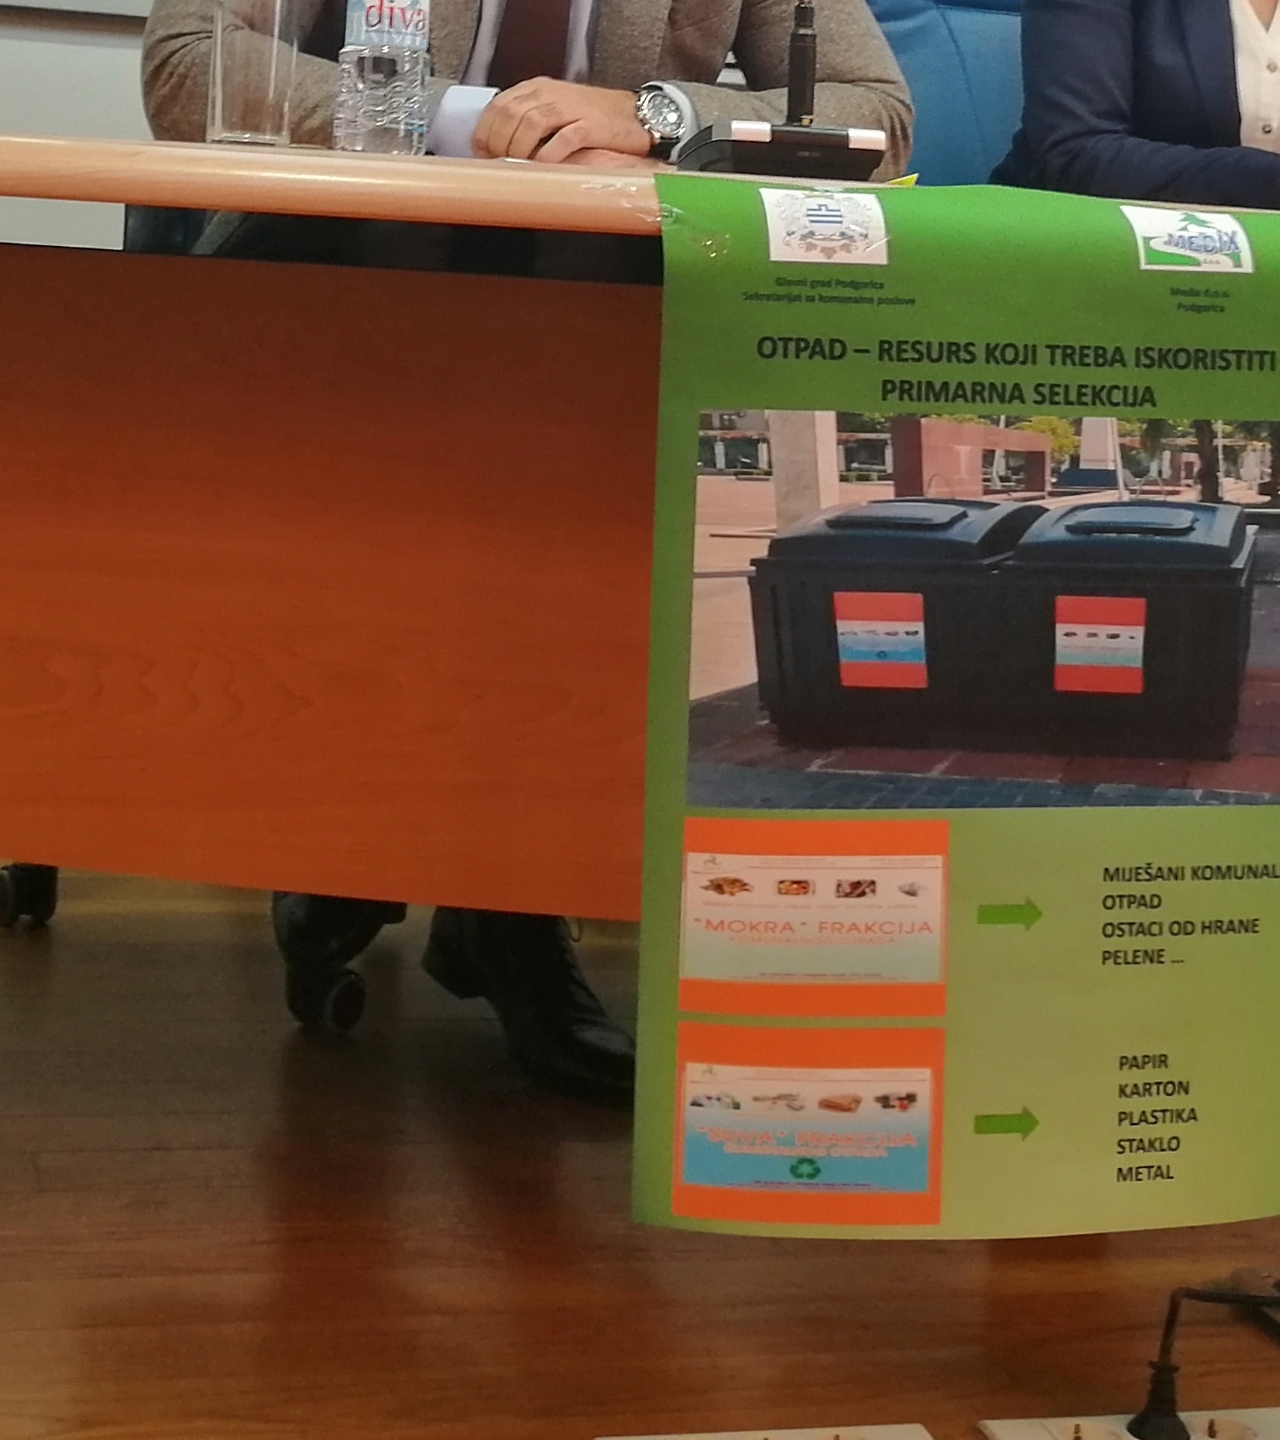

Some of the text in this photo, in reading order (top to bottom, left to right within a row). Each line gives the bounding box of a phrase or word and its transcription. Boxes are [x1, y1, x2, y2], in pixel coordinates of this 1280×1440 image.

[1166, 229, 1240, 255] MEDIX
[756, 335, 847, 361] OTPAD
[877, 338, 978, 364] RESURS
[984, 341, 1039, 368] KOJI
[1044, 343, 1126, 369] TREBA
[1133, 345, 1277, 372] ISKORISTITI
[880, 378, 1158, 408] PRIMARNA SELEKCIJA
[1102, 862, 1186, 883] MIJEŠANI
[1101, 893, 1163, 911] OTPAD
[818, 919, 934, 936] FRAKCIJA
[1101, 917, 1261, 938] OSTACI OD HRANE
[1101, 948, 1166, 966] PELENE
[1118, 1054, 1169, 1071] PAPIR
[1118, 1080, 1190, 1099] KARTON
[1117, 1107, 1199, 1127] PLASTIKA
[1116, 1135, 1181, 1155] STAKLO
[1116, 1164, 1175, 1183] METAL
